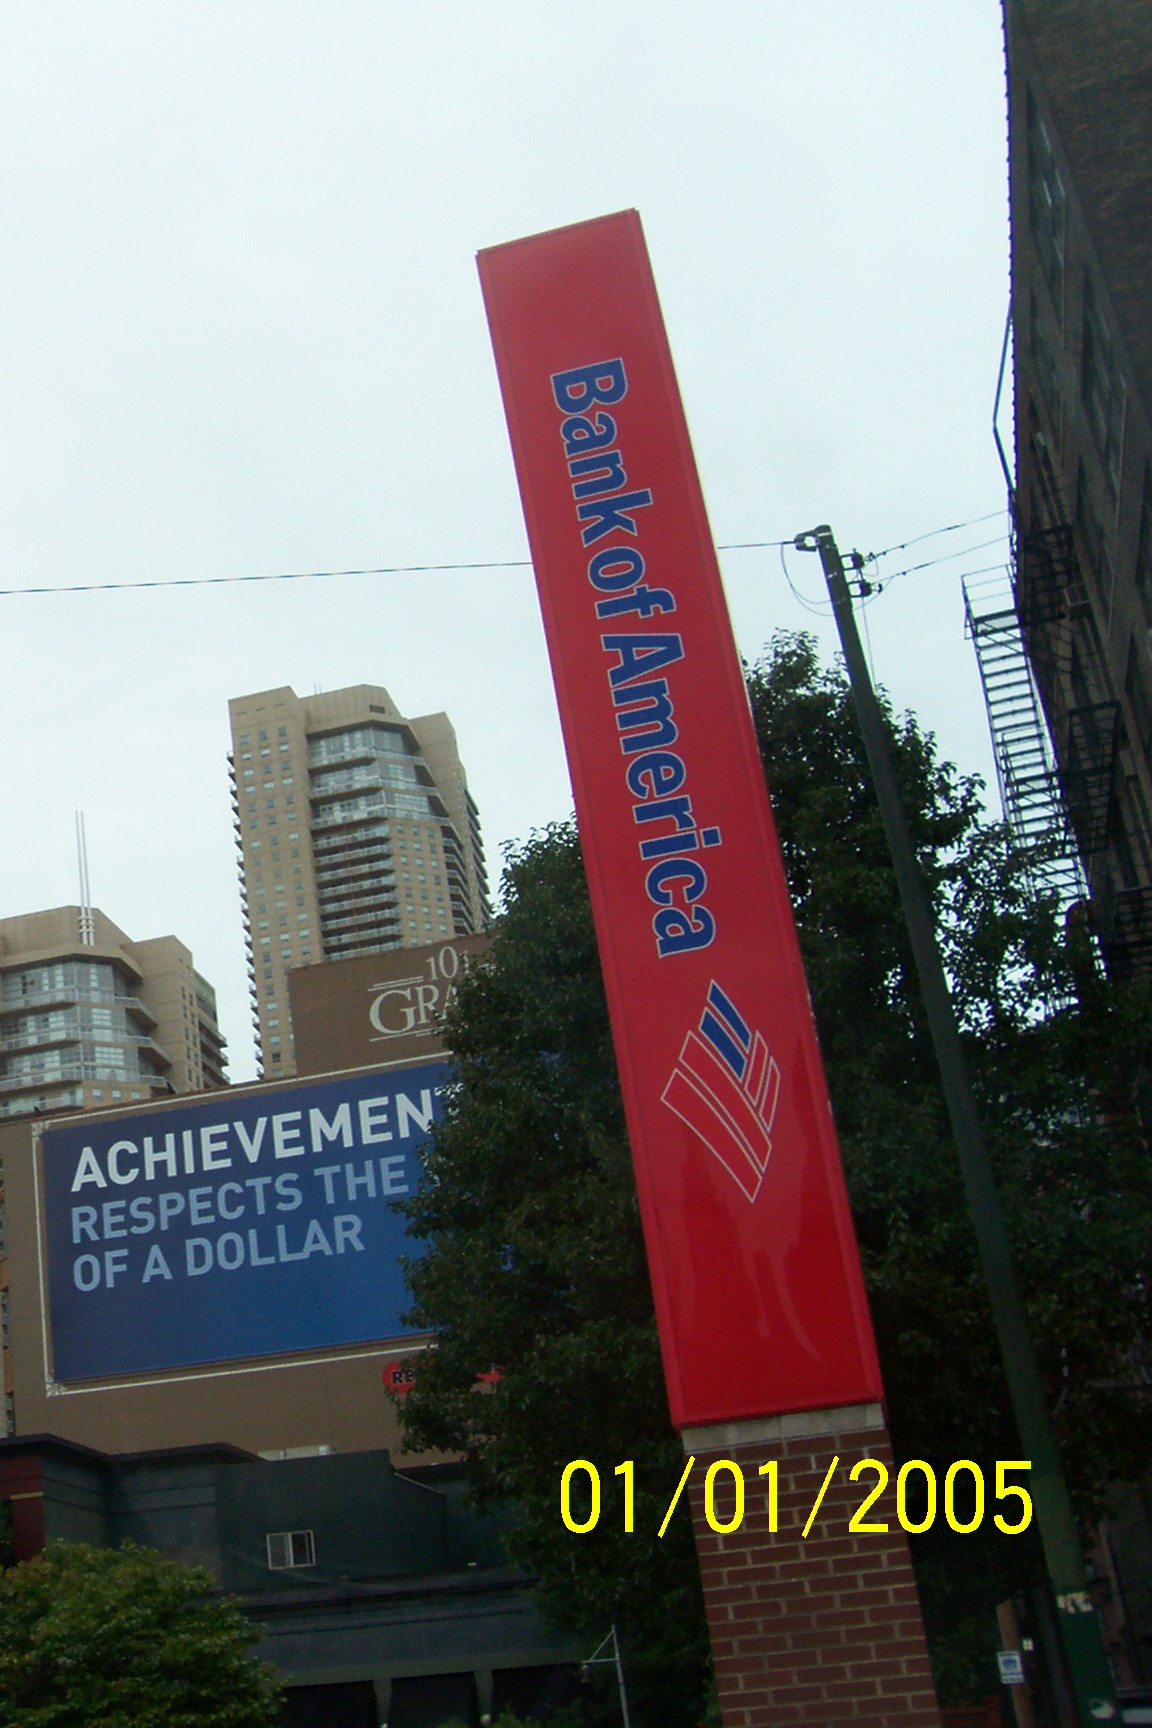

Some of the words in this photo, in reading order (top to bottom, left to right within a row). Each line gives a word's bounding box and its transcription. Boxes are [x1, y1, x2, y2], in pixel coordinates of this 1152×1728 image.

[550, 358, 653, 547] Bank
[588, 546, 676, 619] of
[601, 633, 722, 958] America
[71, 1083, 458, 1192] ACHIEVEMEN
[71, 1172, 303, 1244] RESPECTS
[314, 1155, 409, 1204] THE
[73, 1249, 129, 1292] OF
[142, 1244, 173, 1283] A
[185, 1214, 365, 1277] DOLLAR
